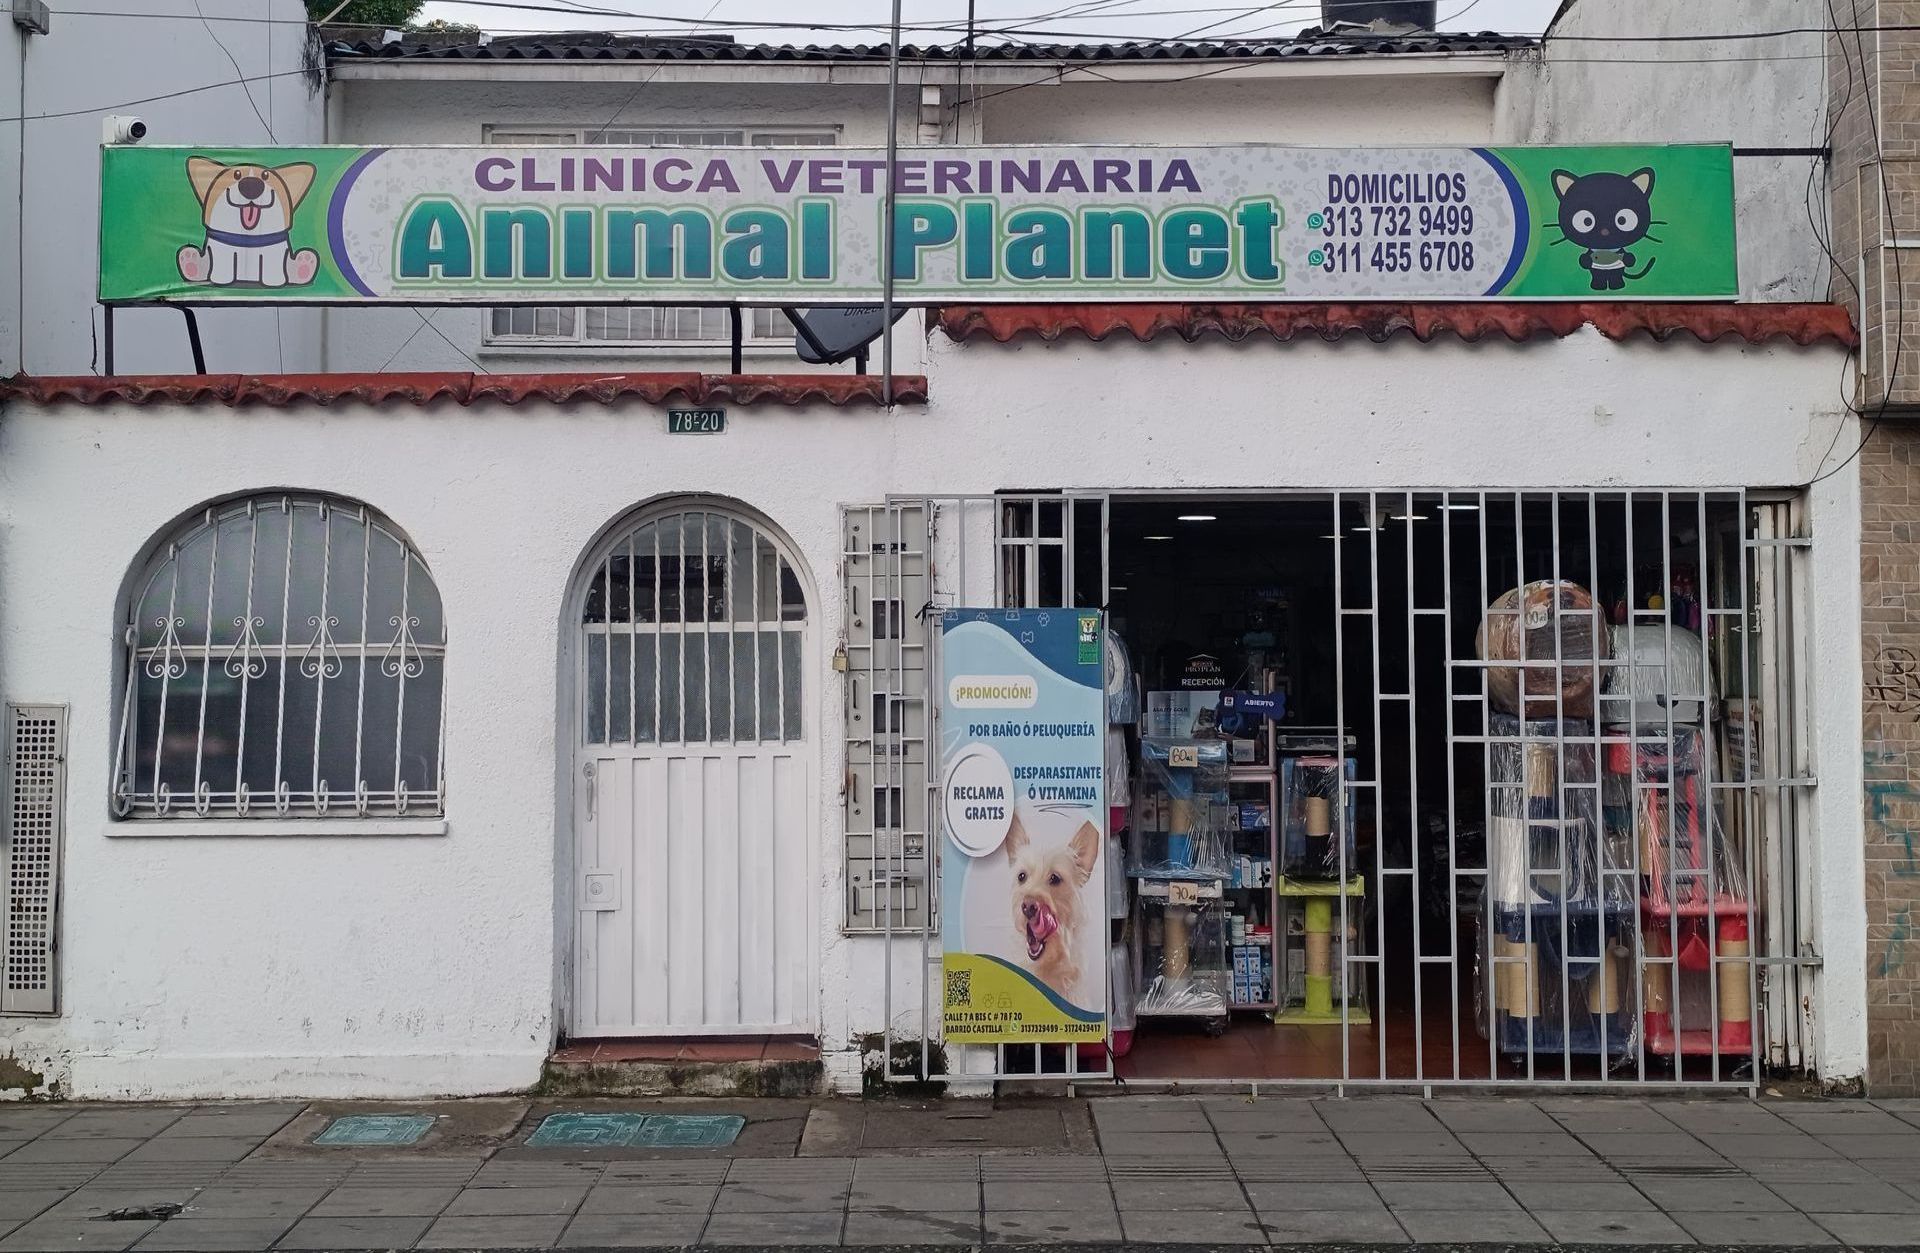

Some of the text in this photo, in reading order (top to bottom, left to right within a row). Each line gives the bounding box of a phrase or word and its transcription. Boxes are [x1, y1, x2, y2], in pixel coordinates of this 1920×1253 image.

[474, 157, 1202, 194] CLINICA VETERINARIA
[1328, 173, 1466, 204] DOMICILIOS
[1322, 205, 1473, 237] 313 732 9499
[402, 200, 1279, 282] Animal Planet
[1322, 241, 1474, 273] 311 455 6708
[1181, 677, 1225, 686] RECEPCIÓN
[956, 683, 1032, 701] ¡PROMOCIÓN!
[1244, 699, 1275, 707] ABIERTO
[969, 721, 1095, 739] POR BAÑO Ó PELUQUERÍA
[1014, 767, 1101, 780] DESPARASITANTE
[953, 786, 1005, 800] RECLAMA
[1028, 783, 1097, 800] Ó VITAMINA
[965, 806, 1005, 820] GRATIS
[944, 1013, 963, 1021] CALLE
[969, 1013, 974, 1021] A
[975, 1013, 986, 1021] BIS
[1013, 1012, 1023, 1021] 20
[945, 1025, 971, 1033] BARRIO
[972, 1025, 1003, 1033] CASTILLA
